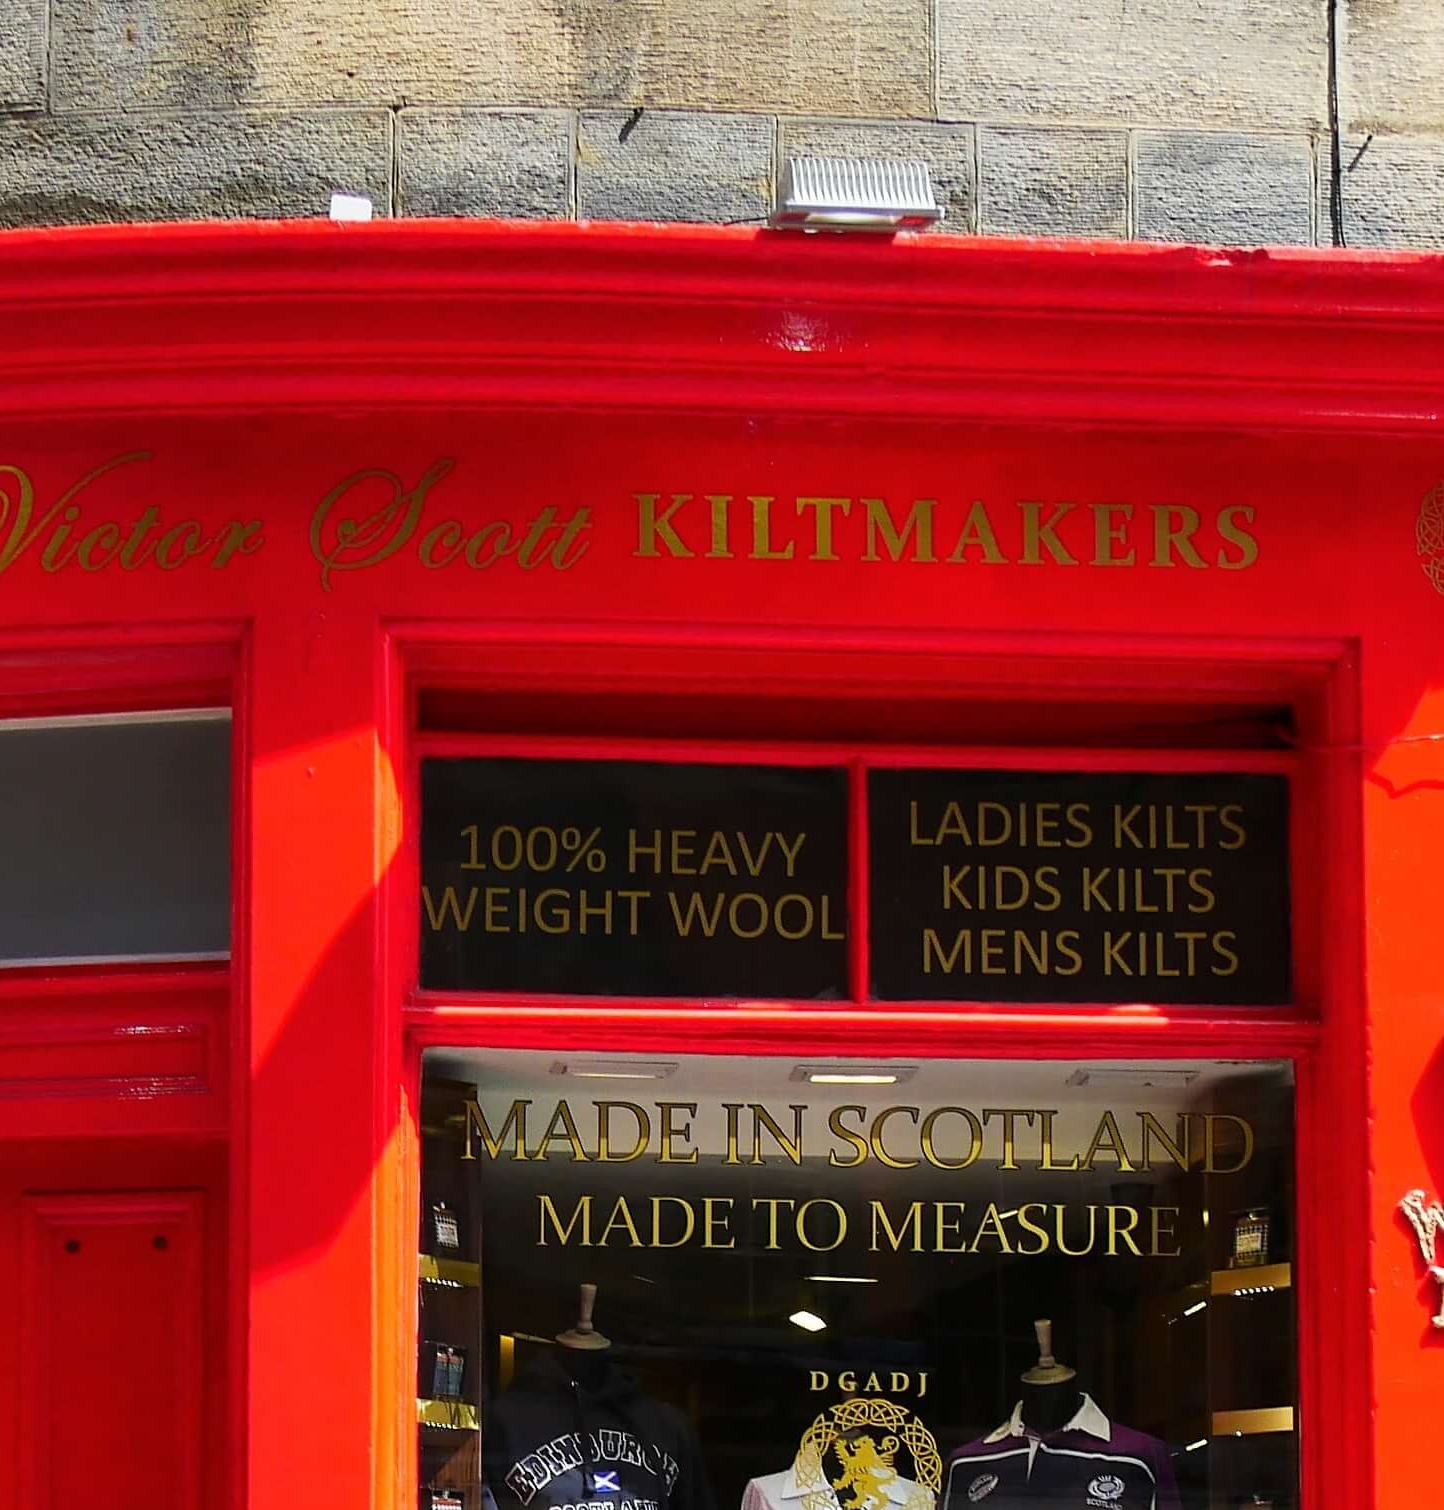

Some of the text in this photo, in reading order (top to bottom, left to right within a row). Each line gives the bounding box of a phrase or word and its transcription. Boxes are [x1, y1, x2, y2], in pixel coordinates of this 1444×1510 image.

[309, 457, 594, 593] Scott
[632, 492, 1261, 570] KILTMAKERS
[460, 825, 807, 878] 100% HEAVY
[910, 801, 1247, 851] LADIES KILTS
[422, 886, 845, 941] WEIGHT WOOL
[942, 866, 1216, 913] KIDS KILTS
[922, 928, 1239, 977] MENS KILTS
[462, 1099, 1254, 1174] MADE IN SCOTLAND
[536, 1194, 1182, 1258] MADE TO MEASURE
[809, 1370, 930, 1398] DGADJ
